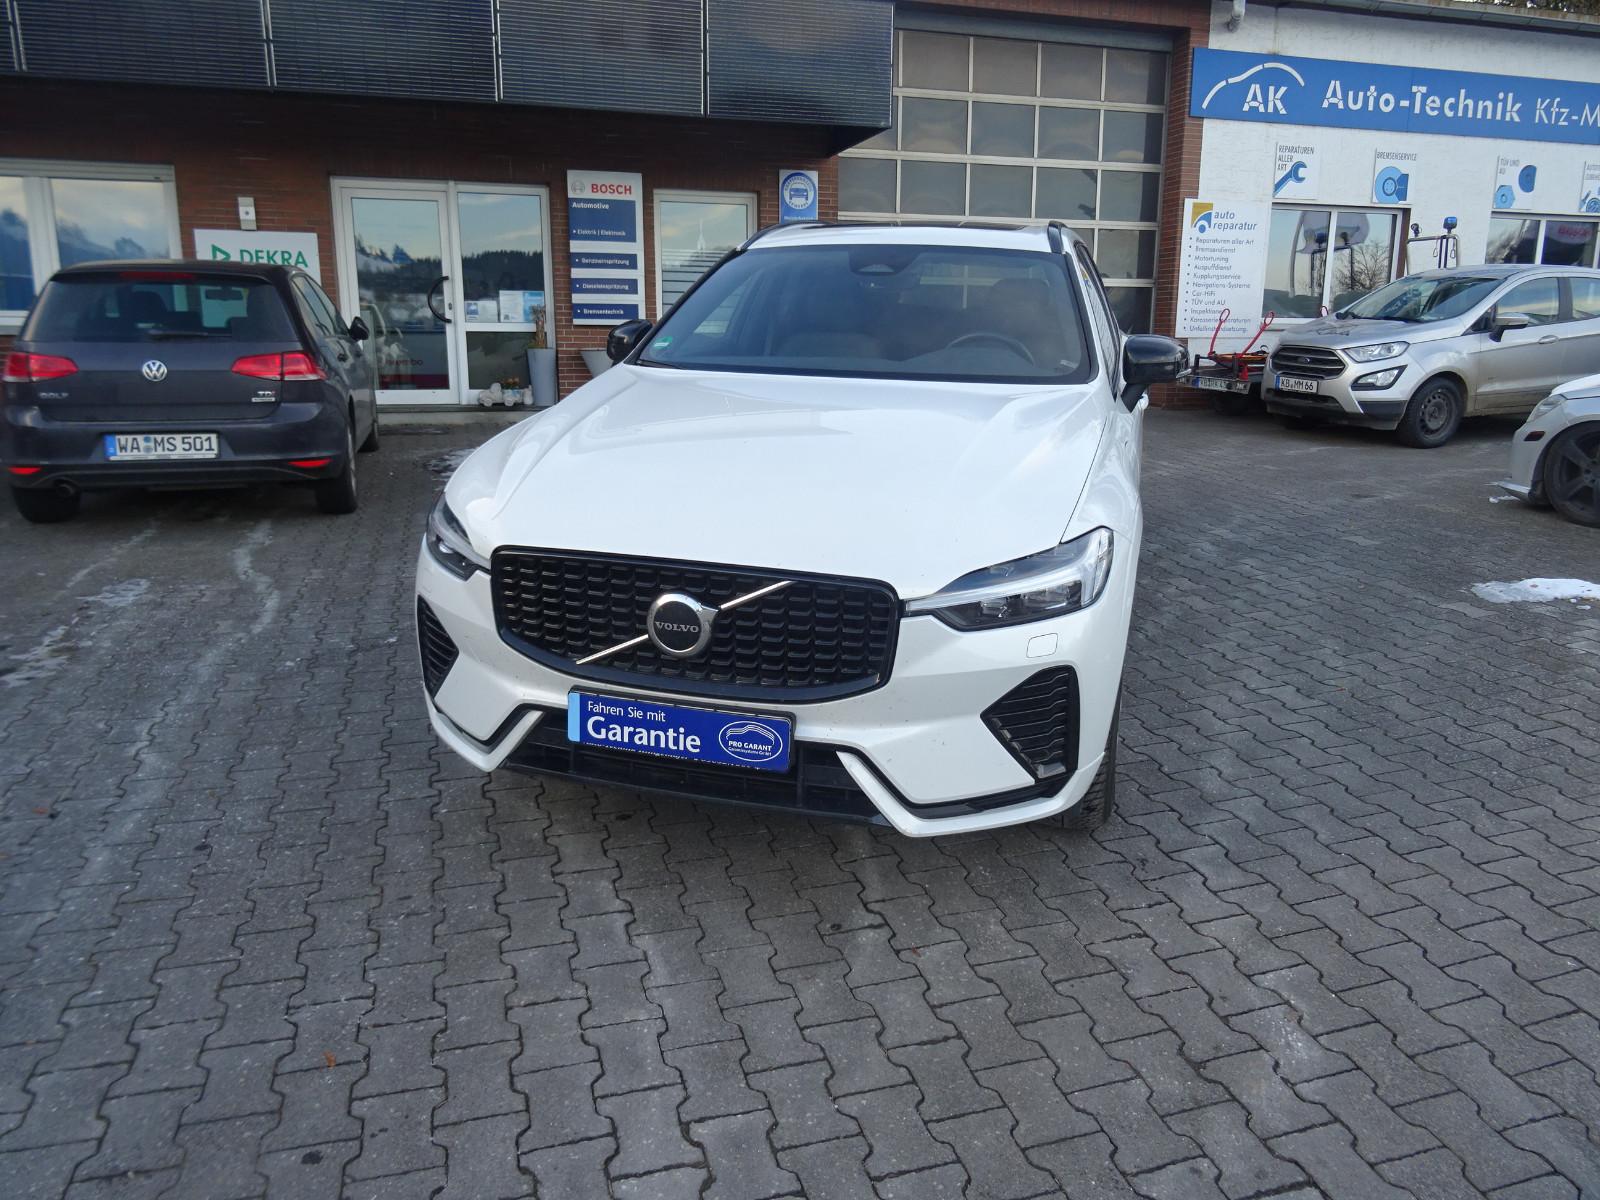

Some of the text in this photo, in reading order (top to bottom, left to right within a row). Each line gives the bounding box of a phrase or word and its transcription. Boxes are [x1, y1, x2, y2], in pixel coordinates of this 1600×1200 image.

[1242, 83, 1288, 115] AK
[1321, 79, 1522, 123] Auto-Technik
[1278, 144, 1315, 155] REPARATUREN
[1277, 155, 1294, 163] ALLER
[1376, 151, 1418, 162] BREMSENSERVICE
[1277, 163, 1288, 171] ART
[591, 183, 632, 195] BOSCH
[572, 202, 610, 210] Automotive
[1214, 211, 1236, 220] auto
[1213, 221, 1258, 232] reparatur
[600, 229, 626, 237] Elektronik
[239, 248, 309, 268] DEKRA
[1281, 379, 1290, 388] KB
[1304, 381, 1314, 391] 66
[117, 436, 215, 453] WA MS 501
[655, 620, 700, 633] VOLVO
[587, 701, 666, 722] Fahren Sie mit
[587, 716, 701, 753] Garantie
[728, 740, 772, 752] PRO GARANT
